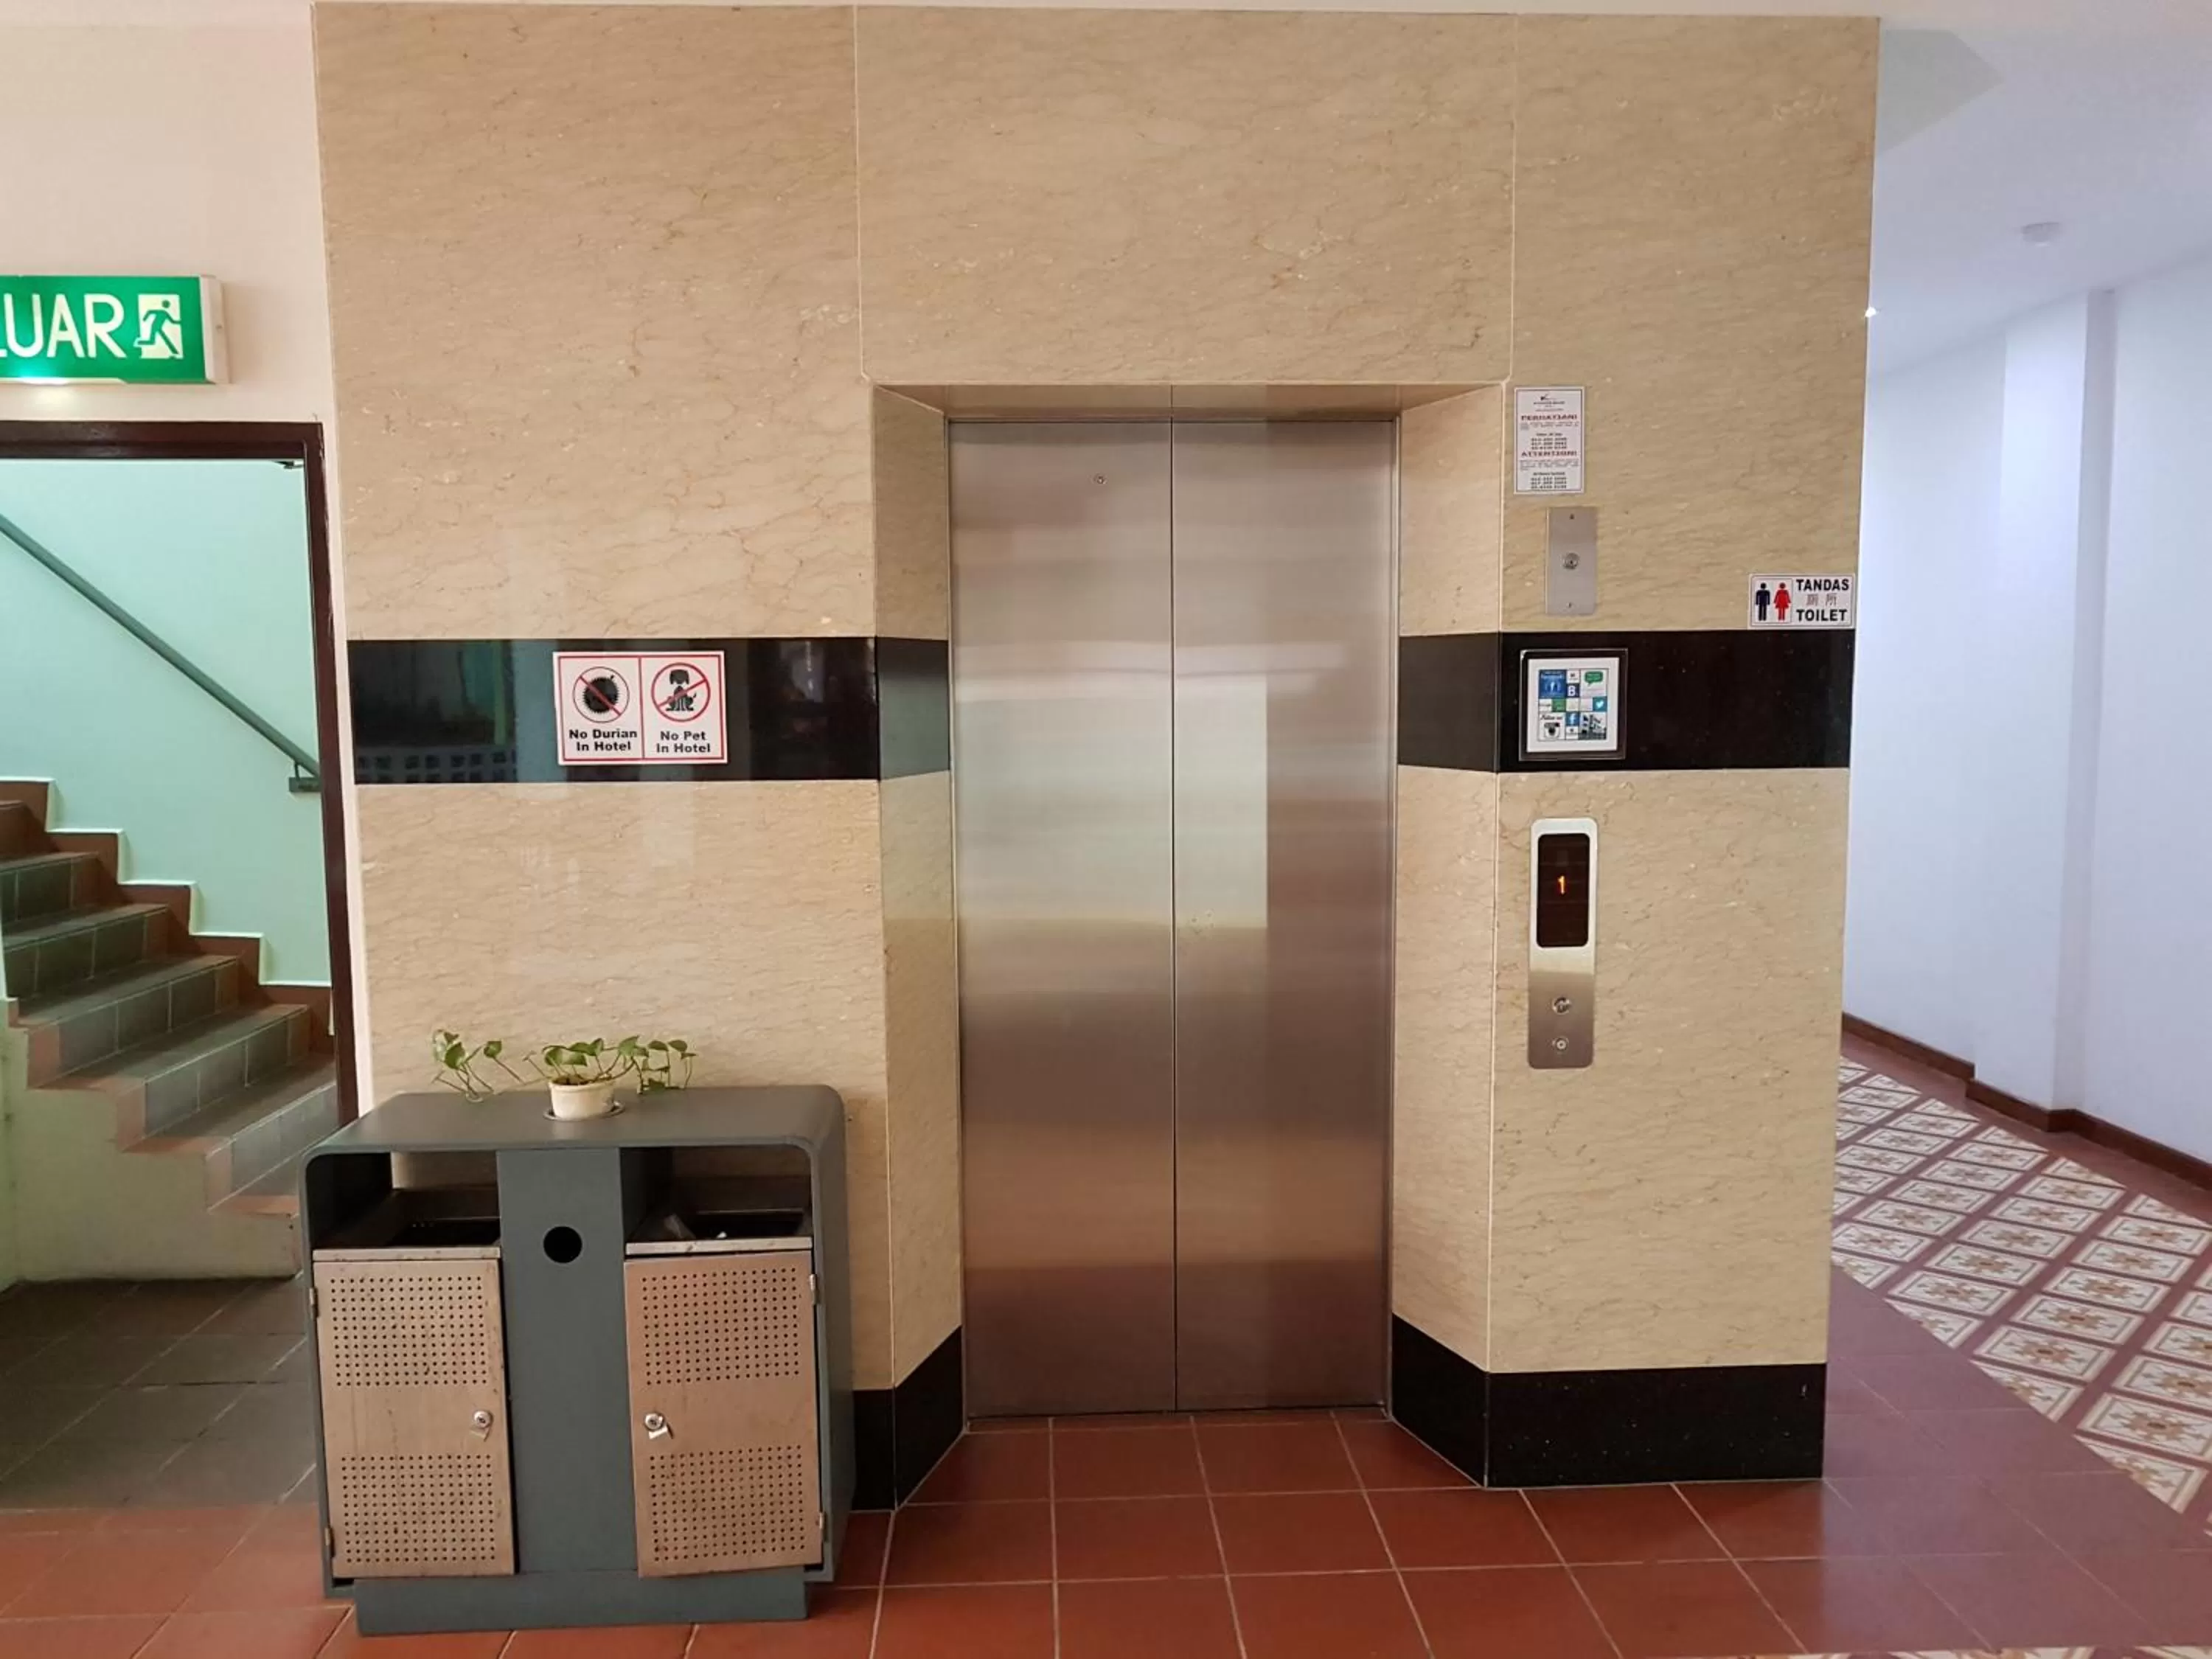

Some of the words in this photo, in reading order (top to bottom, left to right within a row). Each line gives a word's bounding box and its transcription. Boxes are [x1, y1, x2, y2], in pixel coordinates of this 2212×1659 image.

[1796, 579, 1849, 591] TANDAS
[1796, 609, 1848, 622] TOILET
[568, 728, 588, 739] No
[593, 728, 638, 739] Durian
[660, 731, 679, 741] No
[684, 731, 707, 740] Pet
[577, 741, 589, 751] In
[594, 741, 631, 751] Hotel
[656, 743, 669, 753] In
[674, 743, 711, 753] Hotel
[1557, 875, 1565, 894] 1
